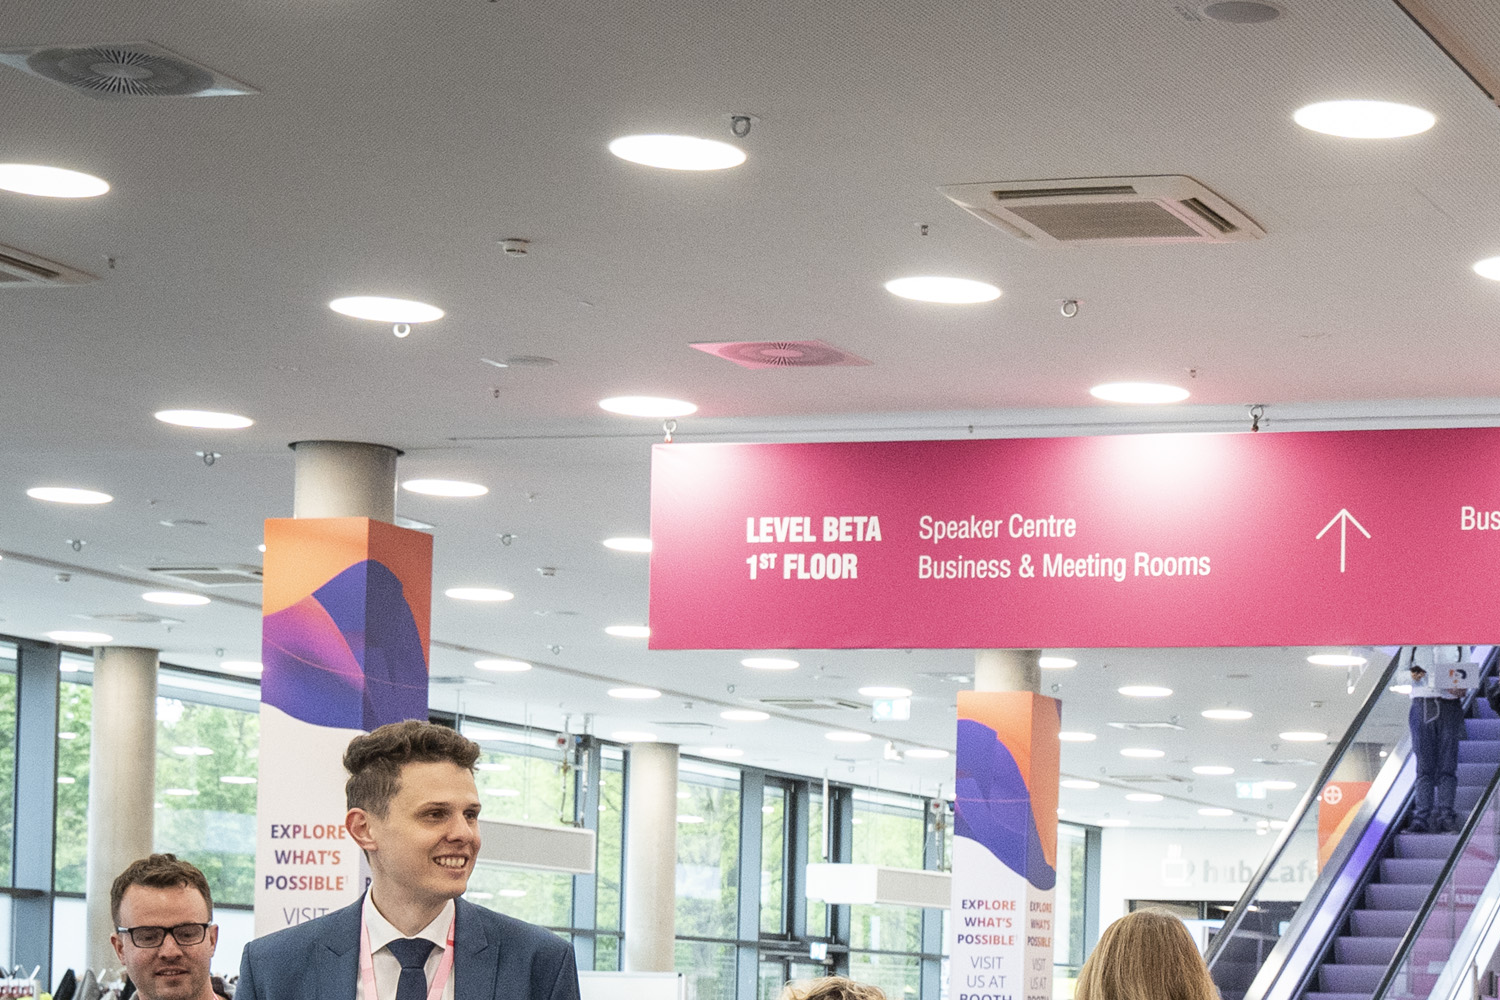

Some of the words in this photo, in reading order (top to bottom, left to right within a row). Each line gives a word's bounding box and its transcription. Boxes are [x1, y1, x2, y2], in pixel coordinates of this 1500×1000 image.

[746, 516, 816, 543] LEVEL
[823, 515, 882, 542] BETA
[919, 516, 1002, 546] Speaker
[1008, 513, 1076, 539] Centre
[746, 553, 777, 580] 1ST
[784, 553, 858, 580] FLOOR
[919, 553, 1011, 580] Business
[1019, 554, 1035, 578] &
[1043, 553, 1125, 582] Meeting
[1134, 552, 1211, 577] Rooms
[271, 824, 346, 839] EXPLORE
[265, 875, 344, 891] POSSIBLE
[962, 899, 1016, 911] EXPLORE
[1030, 902, 1051, 913] EXPLORE
[957, 934, 1014, 945] POSSIBLE
[1027, 936, 1051, 947] POSSIBLE
[971, 956, 1003, 969] VISIT
[1032, 958, 1046, 970] VISIT
[967, 975, 985, 988] US
[989, 975, 1006, 988] AT
[1031, 977, 1039, 989] US
[1040, 977, 1047, 989] AT
